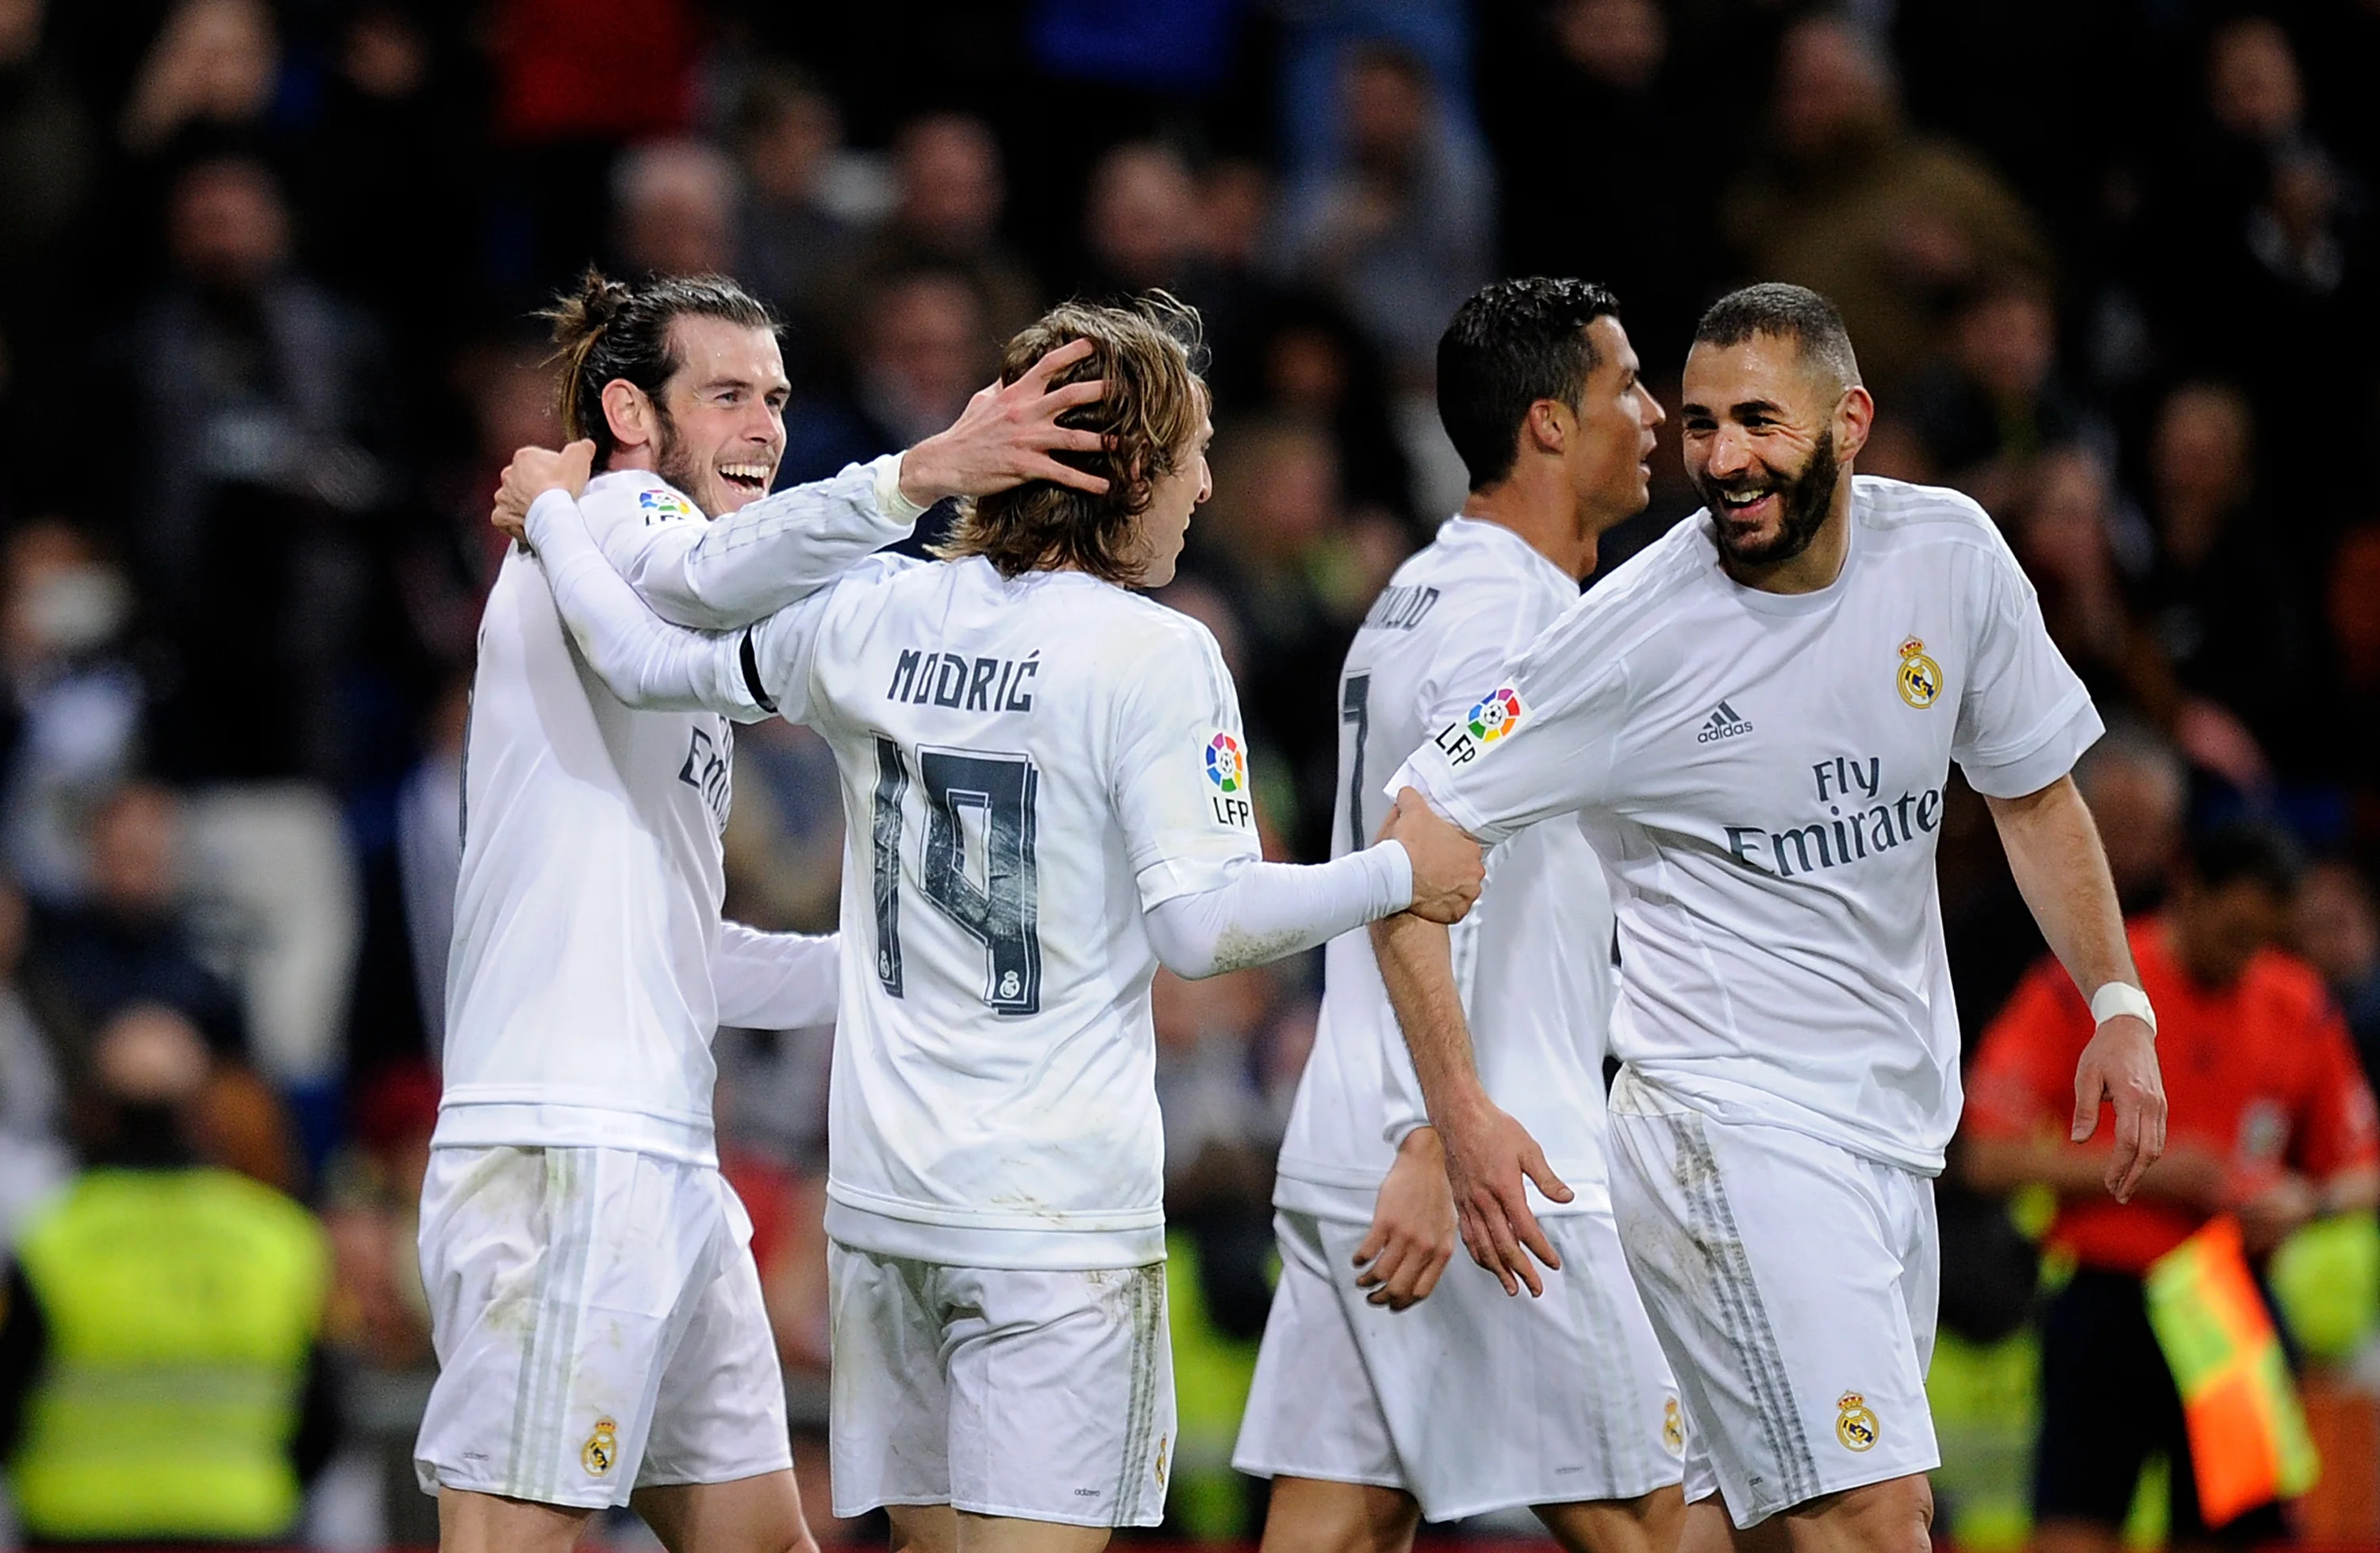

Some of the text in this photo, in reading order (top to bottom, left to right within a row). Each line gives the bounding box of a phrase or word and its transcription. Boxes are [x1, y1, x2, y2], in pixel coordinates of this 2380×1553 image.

[887, 649, 1040, 712] MODRIĆ
[1435, 722, 1476, 767] LFP
[1697, 721, 1753, 743] adidas
[1812, 756, 1880, 802] Fly
[1212, 796, 1249, 828] LFP
[1723, 782, 1947, 877] Emirate
[869, 729, 1042, 1016] 19
